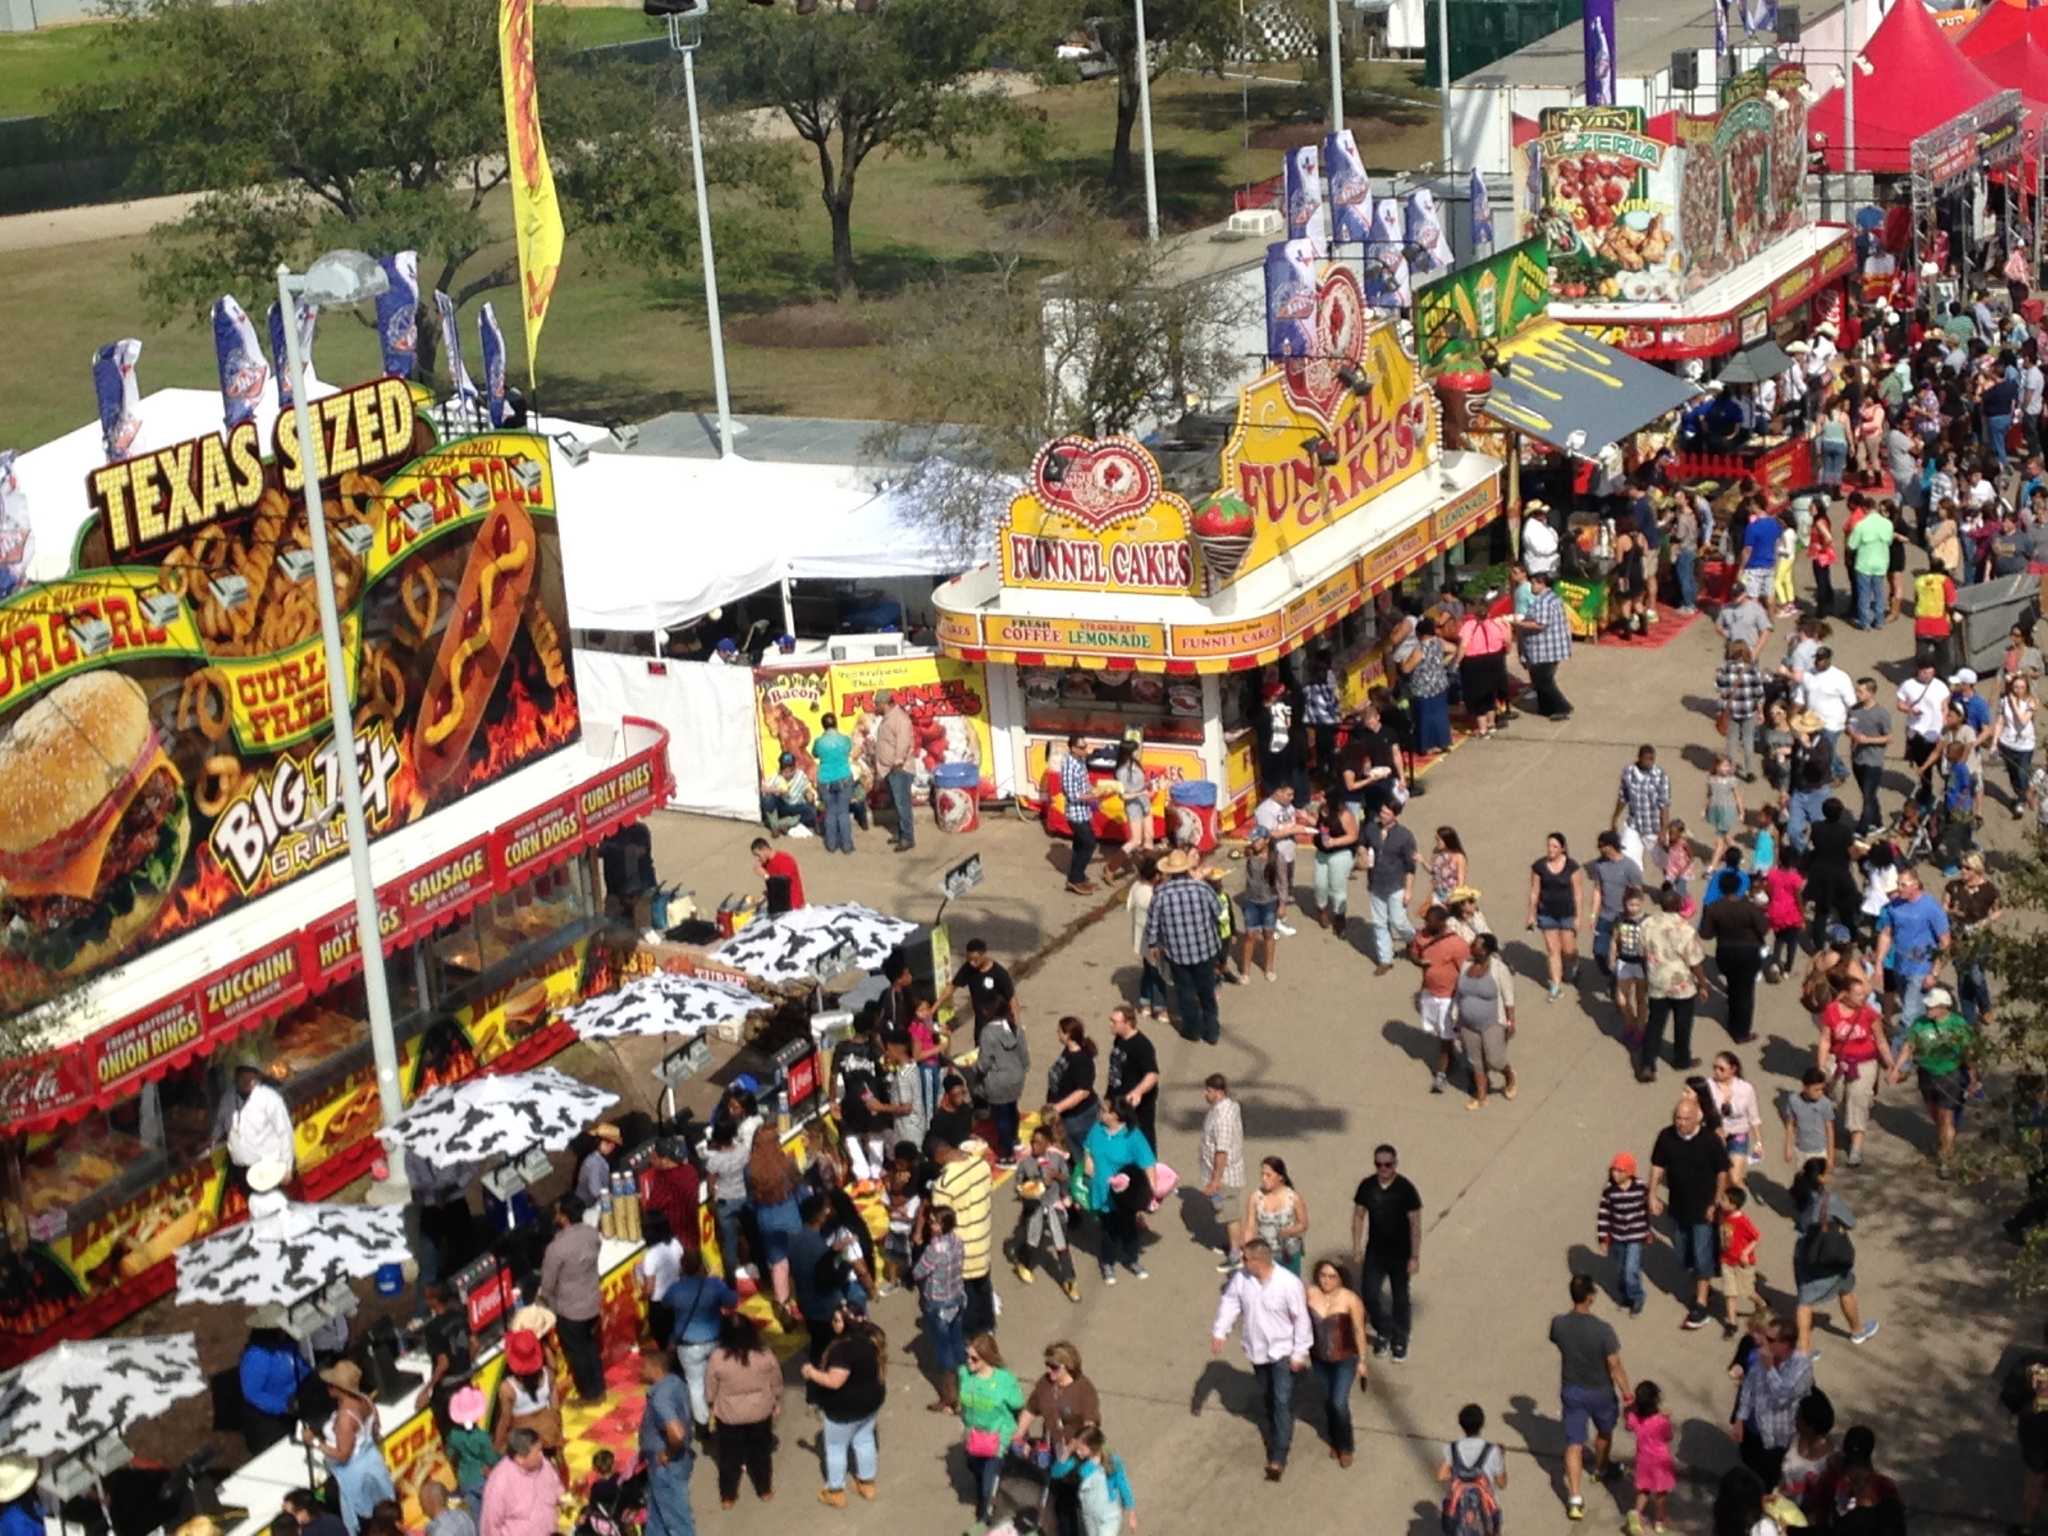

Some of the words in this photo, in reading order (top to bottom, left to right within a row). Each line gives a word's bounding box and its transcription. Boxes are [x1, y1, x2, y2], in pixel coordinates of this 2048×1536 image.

[95, 421, 265, 552] TEXAS
[277, 379, 415, 491] SIZED
[1297, 401, 1416, 526] CAKES
[1010, 534, 1109, 585] FUNNEL
[1112, 540, 1194, 590] CAKES
[1002, 627, 1061, 643] COFFEE
[1011, 618, 1051, 629] FRESH
[1068, 630, 1151, 649] LEMONADE
[1182, 634, 1237, 649] FUNNEL
[236, 648, 328, 706] CURL
[768, 686, 820, 704] Bacon
[249, 687, 330, 743] FRIE
[582, 783, 617, 815] CURLY
[619, 764, 650, 795] FRIES
[214, 761, 306, 882] BIG
[504, 834, 542, 869] CORN
[542, 811, 578, 851] DOGS
[408, 849, 485, 907] SAUSAGE
[319, 929, 354, 968] HOT
[356, 905, 401, 950] GS
[206, 947, 296, 1015] ZUCCHINI
[97, 1038, 151, 1083] ONION
[150, 1010, 199, 1056] RINGS
[105, 1025, 137, 1052] FRESH
